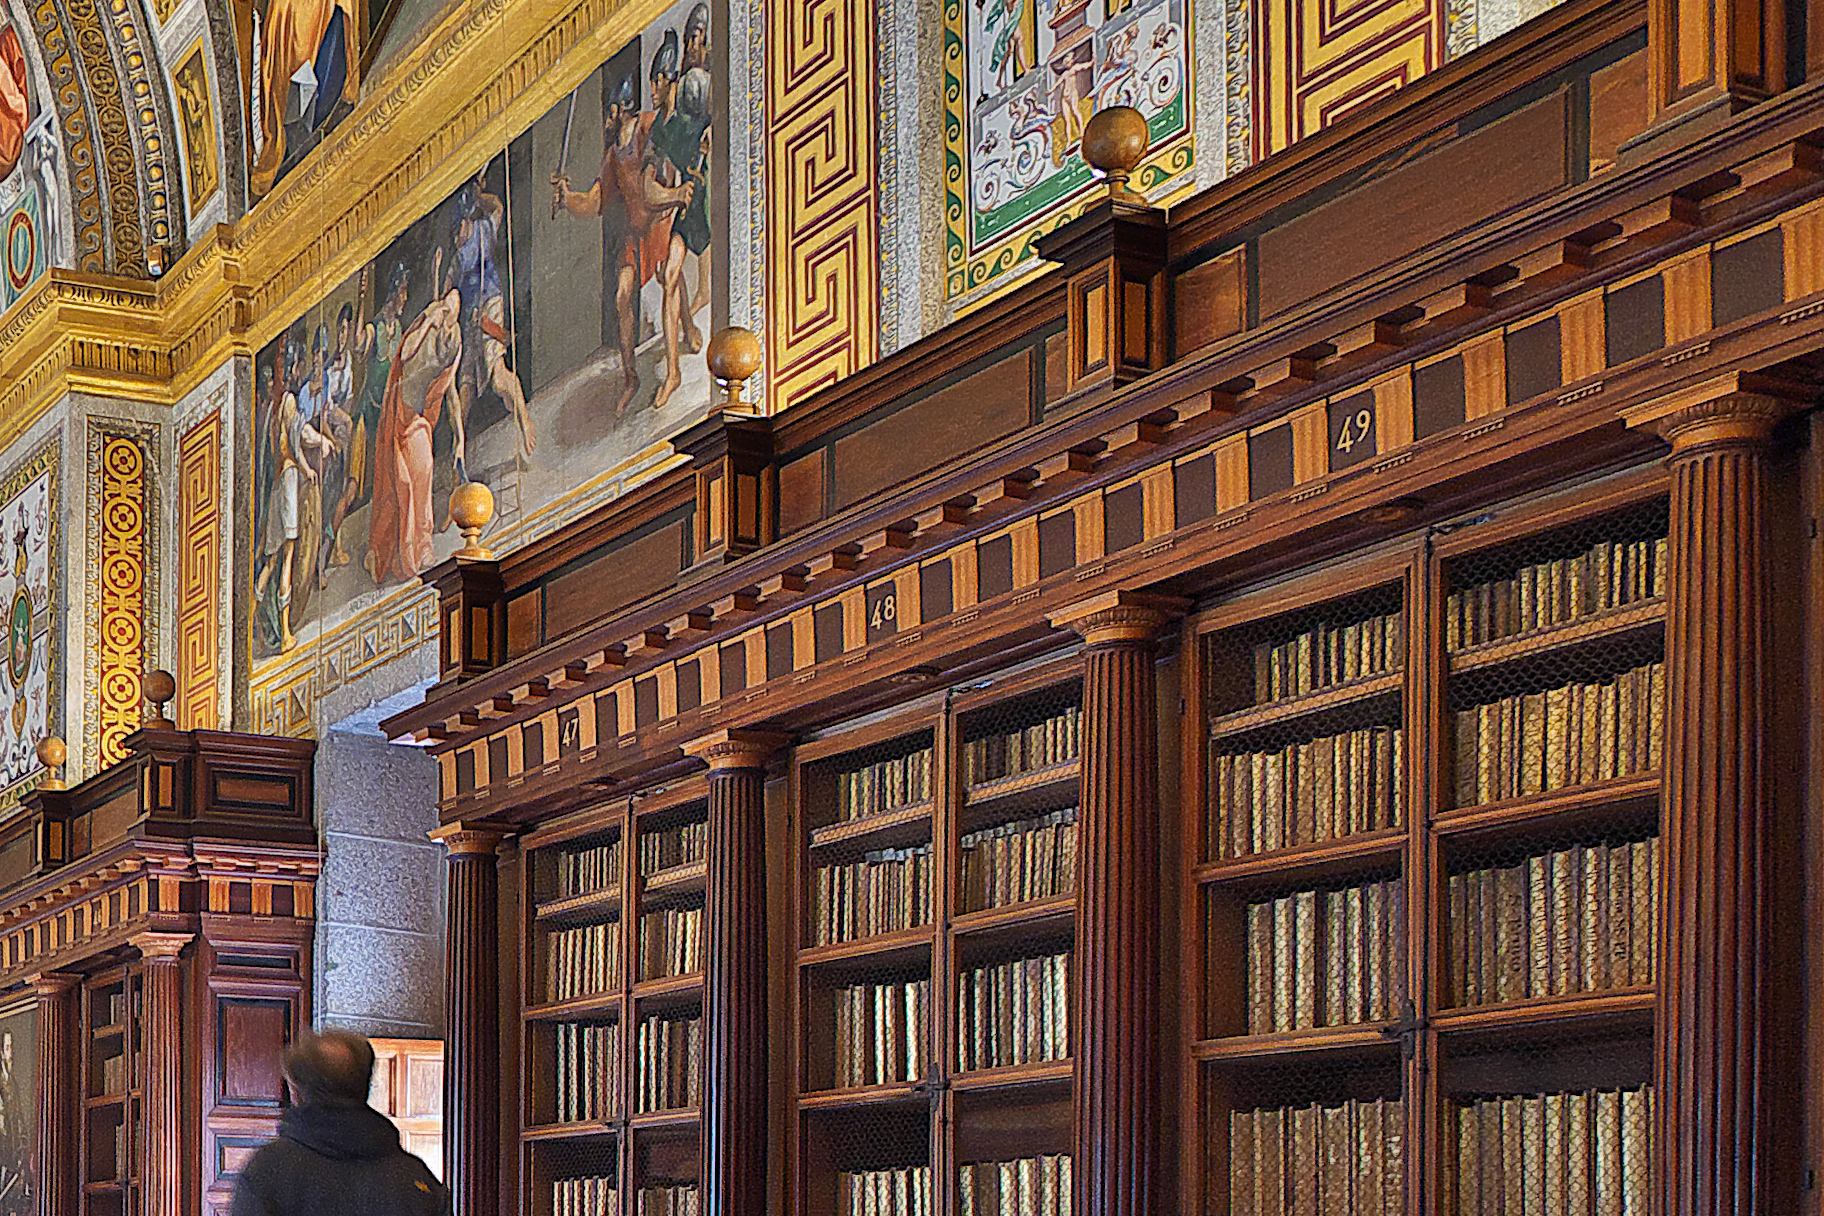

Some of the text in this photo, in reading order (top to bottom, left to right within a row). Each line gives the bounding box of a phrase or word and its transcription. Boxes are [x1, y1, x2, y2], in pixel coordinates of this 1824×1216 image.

[1336, 409, 1371, 453] 49
[870, 595, 895, 630] 48
[562, 717, 578, 747] 47
